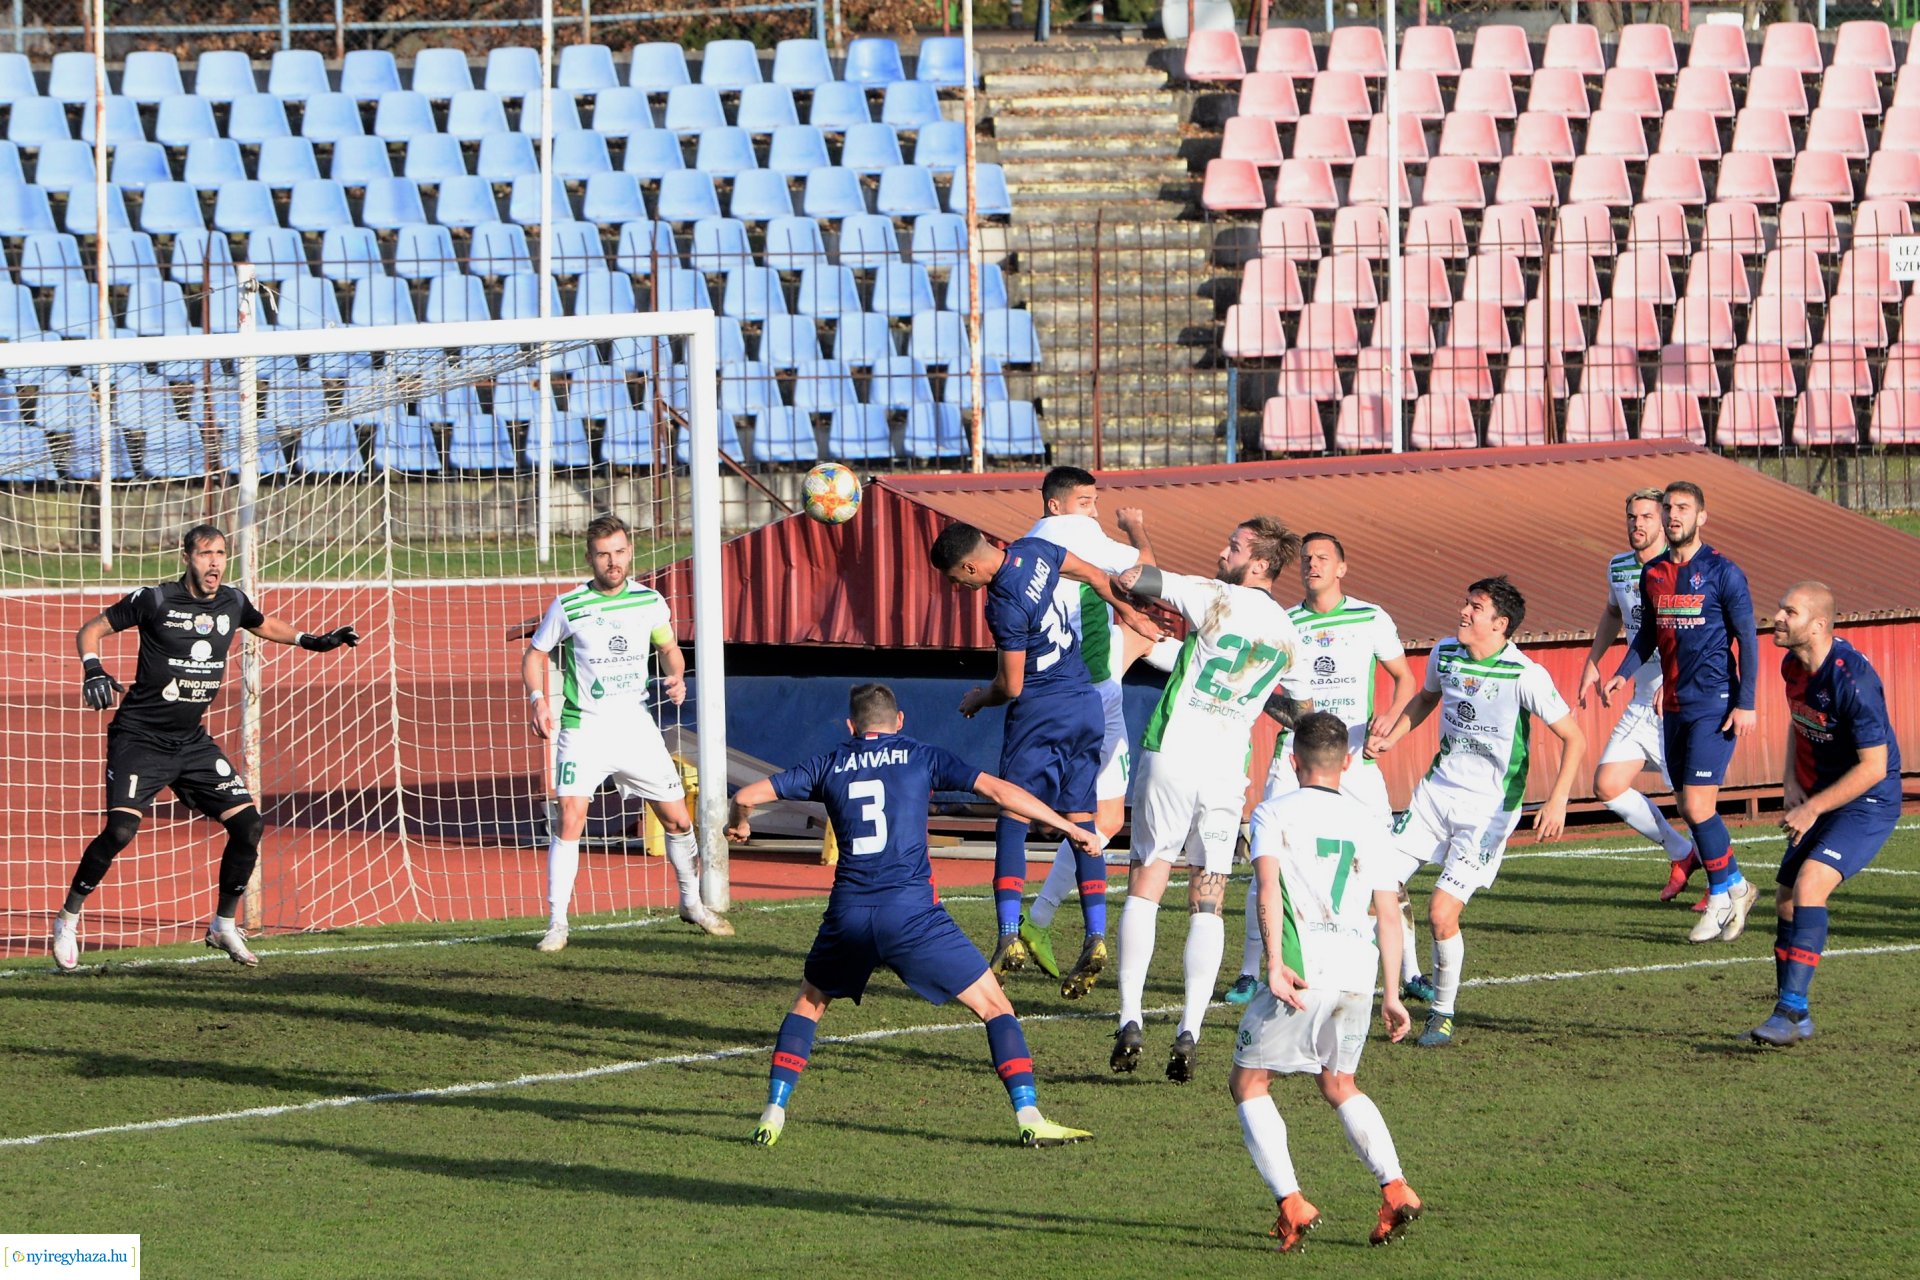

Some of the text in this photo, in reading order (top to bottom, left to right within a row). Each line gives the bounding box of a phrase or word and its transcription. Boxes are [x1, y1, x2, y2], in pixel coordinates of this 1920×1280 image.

[168, 658, 225, 669] SZABADICS
[588, 653, 645, 665] SZABADICS
[601, 674, 624, 684] FINO
[1195, 633, 1289, 706] 27
[178, 679, 221, 689] FINO FRISS
[1332, 697, 1356, 706] FRISS
[1444, 712, 1499, 733] SZABADICS
[834, 747, 909, 774] JÁNVÁRI
[128, 774, 139, 799] 1
[848, 779, 888, 856] 3
[1316, 837, 1356, 915] 7
[1441, 872, 1466, 890] zeus
